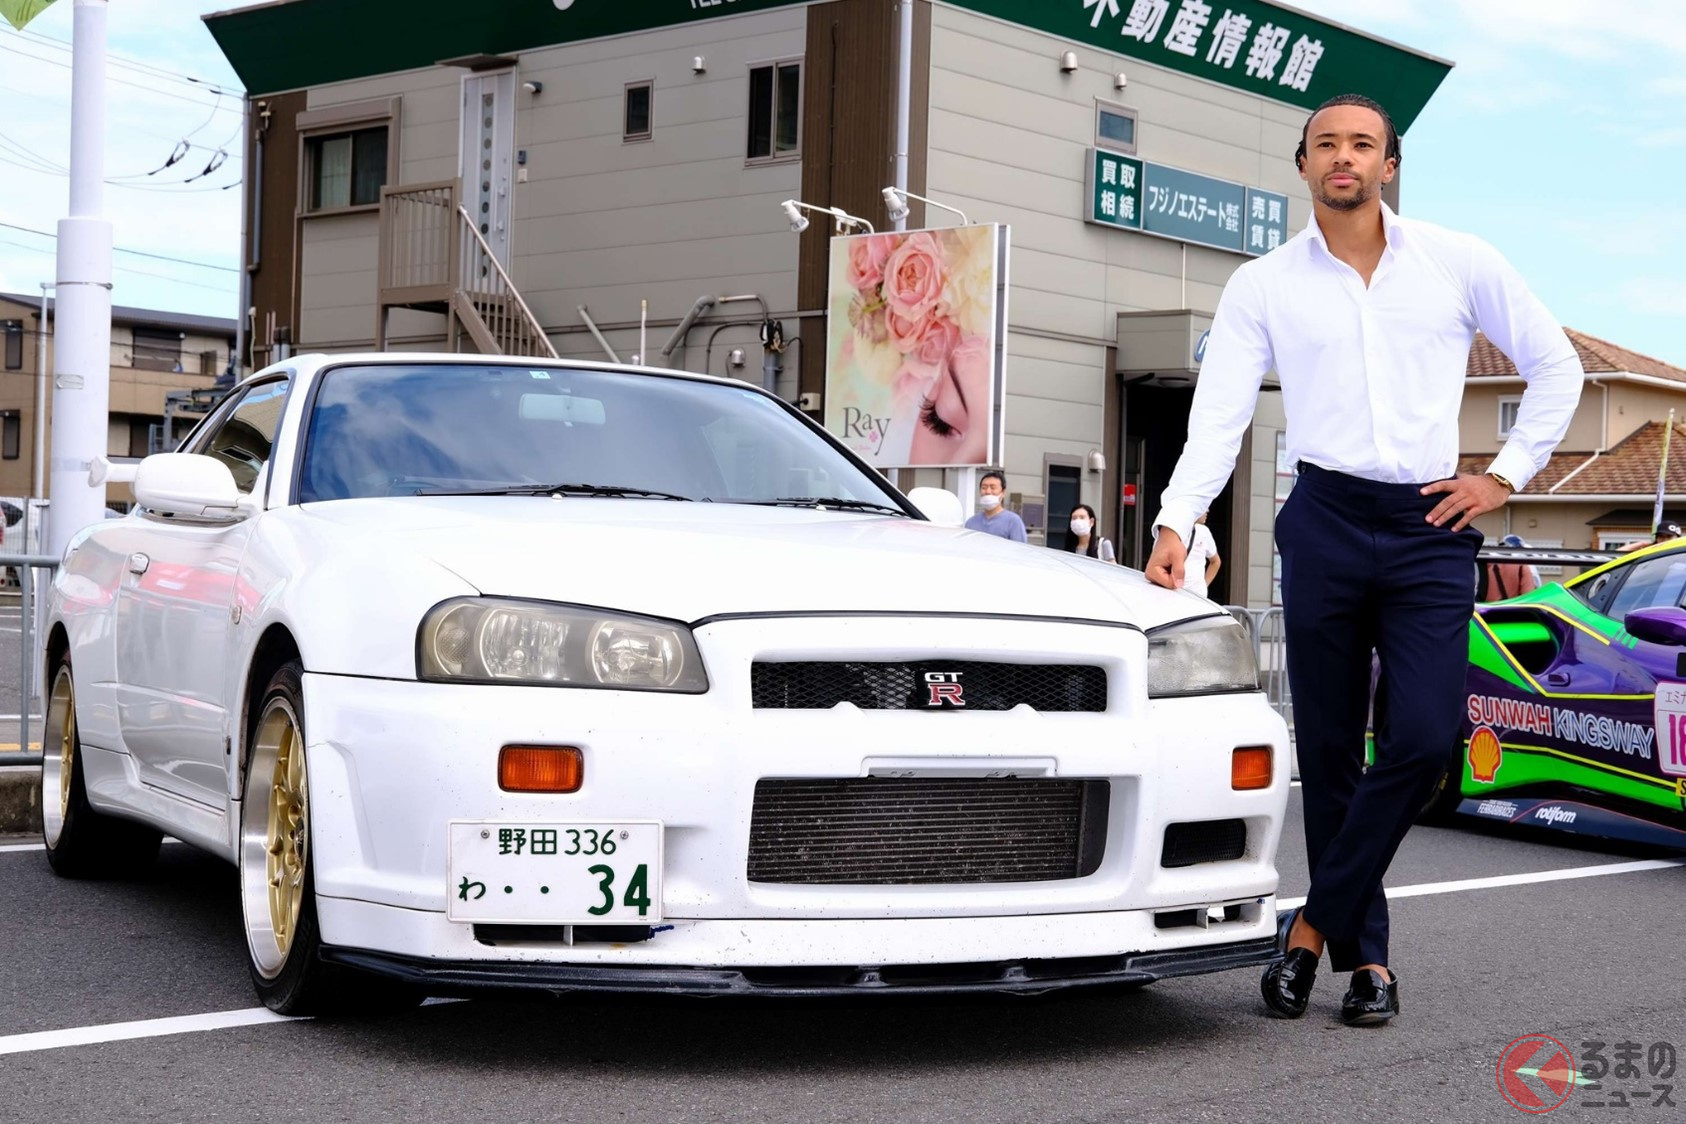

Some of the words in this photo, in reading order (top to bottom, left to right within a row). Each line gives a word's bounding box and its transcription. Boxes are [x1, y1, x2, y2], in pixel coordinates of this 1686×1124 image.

[1102, 159, 1136, 189] 買取
[1101, 190, 1135, 220] 相続
[1149, 186, 1226, 227] フジノエステート
[1252, 196, 1281, 224] 売買
[1251, 225, 1280, 250] 賃貸
[842, 407, 891, 456] Ray
[924, 672, 963, 682] GT
[928, 683, 966, 705] R
[1468, 694, 1551, 736] SUNWAH
[1554, 707, 1655, 759] KINGSWAY
[1535, 806, 1577, 825] rotiform
[499, 828, 557, 855] 野田
[564, 829, 617, 855] 336
[458, 876, 486, 901] わ
